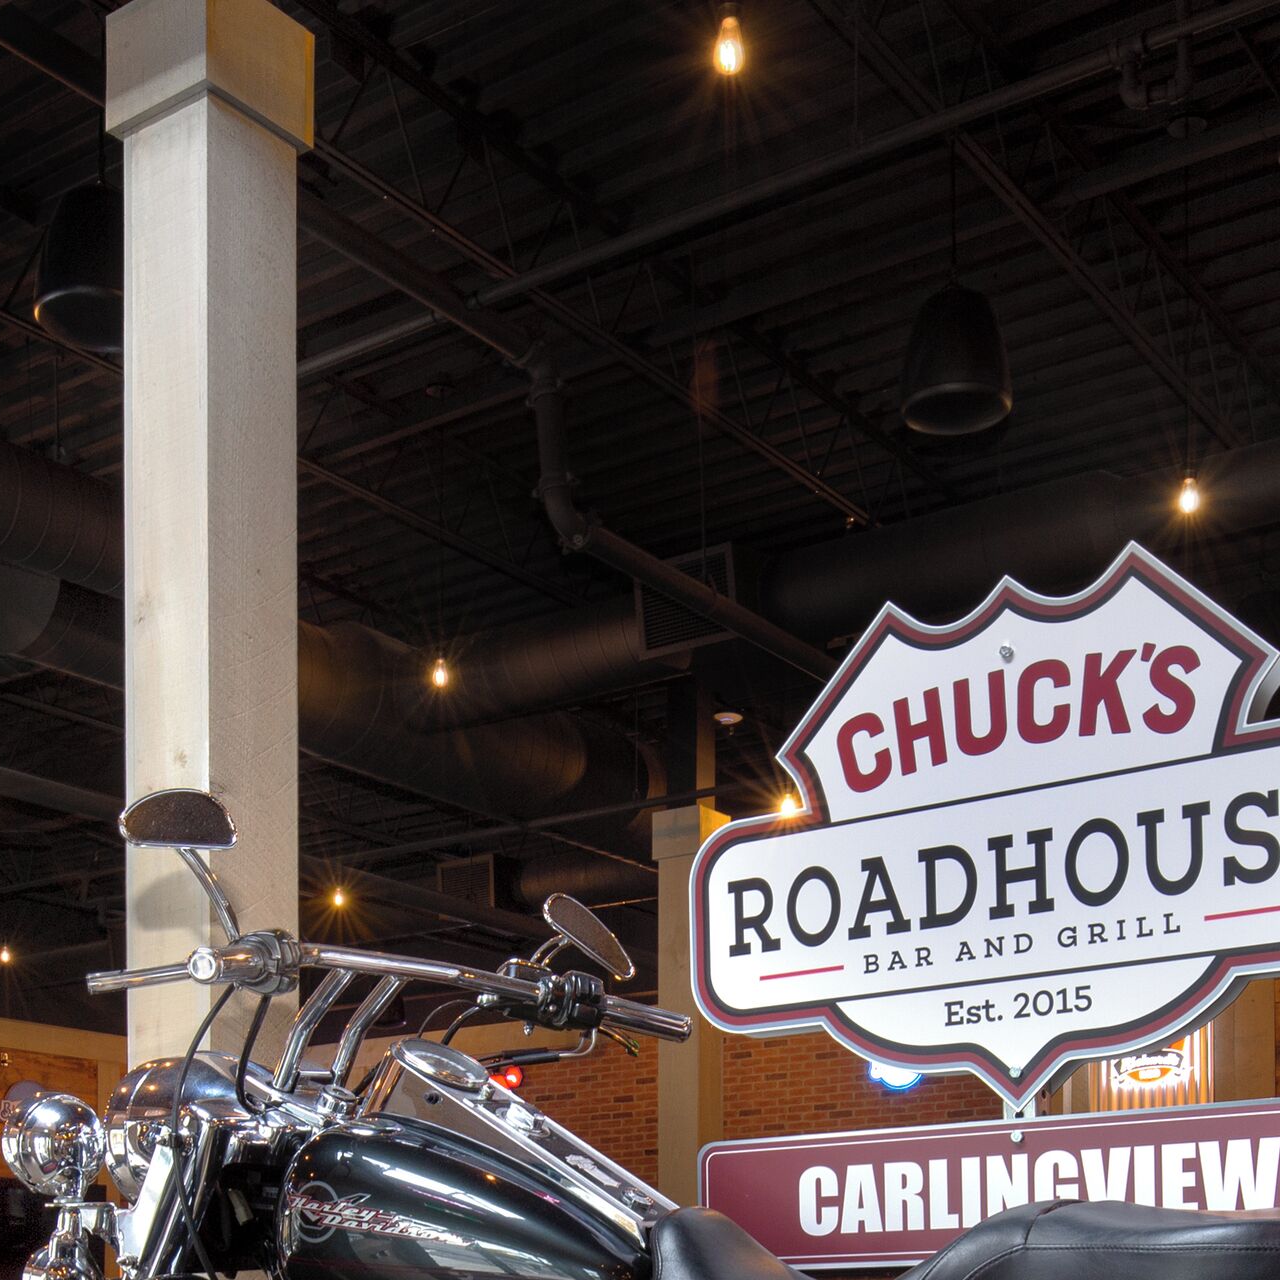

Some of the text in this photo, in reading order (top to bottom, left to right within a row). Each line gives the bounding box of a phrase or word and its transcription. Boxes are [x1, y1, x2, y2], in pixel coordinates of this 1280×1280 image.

[836, 640, 1202, 794] CHUCK'S
[862, 912, 1183, 975] BAR AND GRILL
[943, 984, 1094, 1028] Est. 2015
